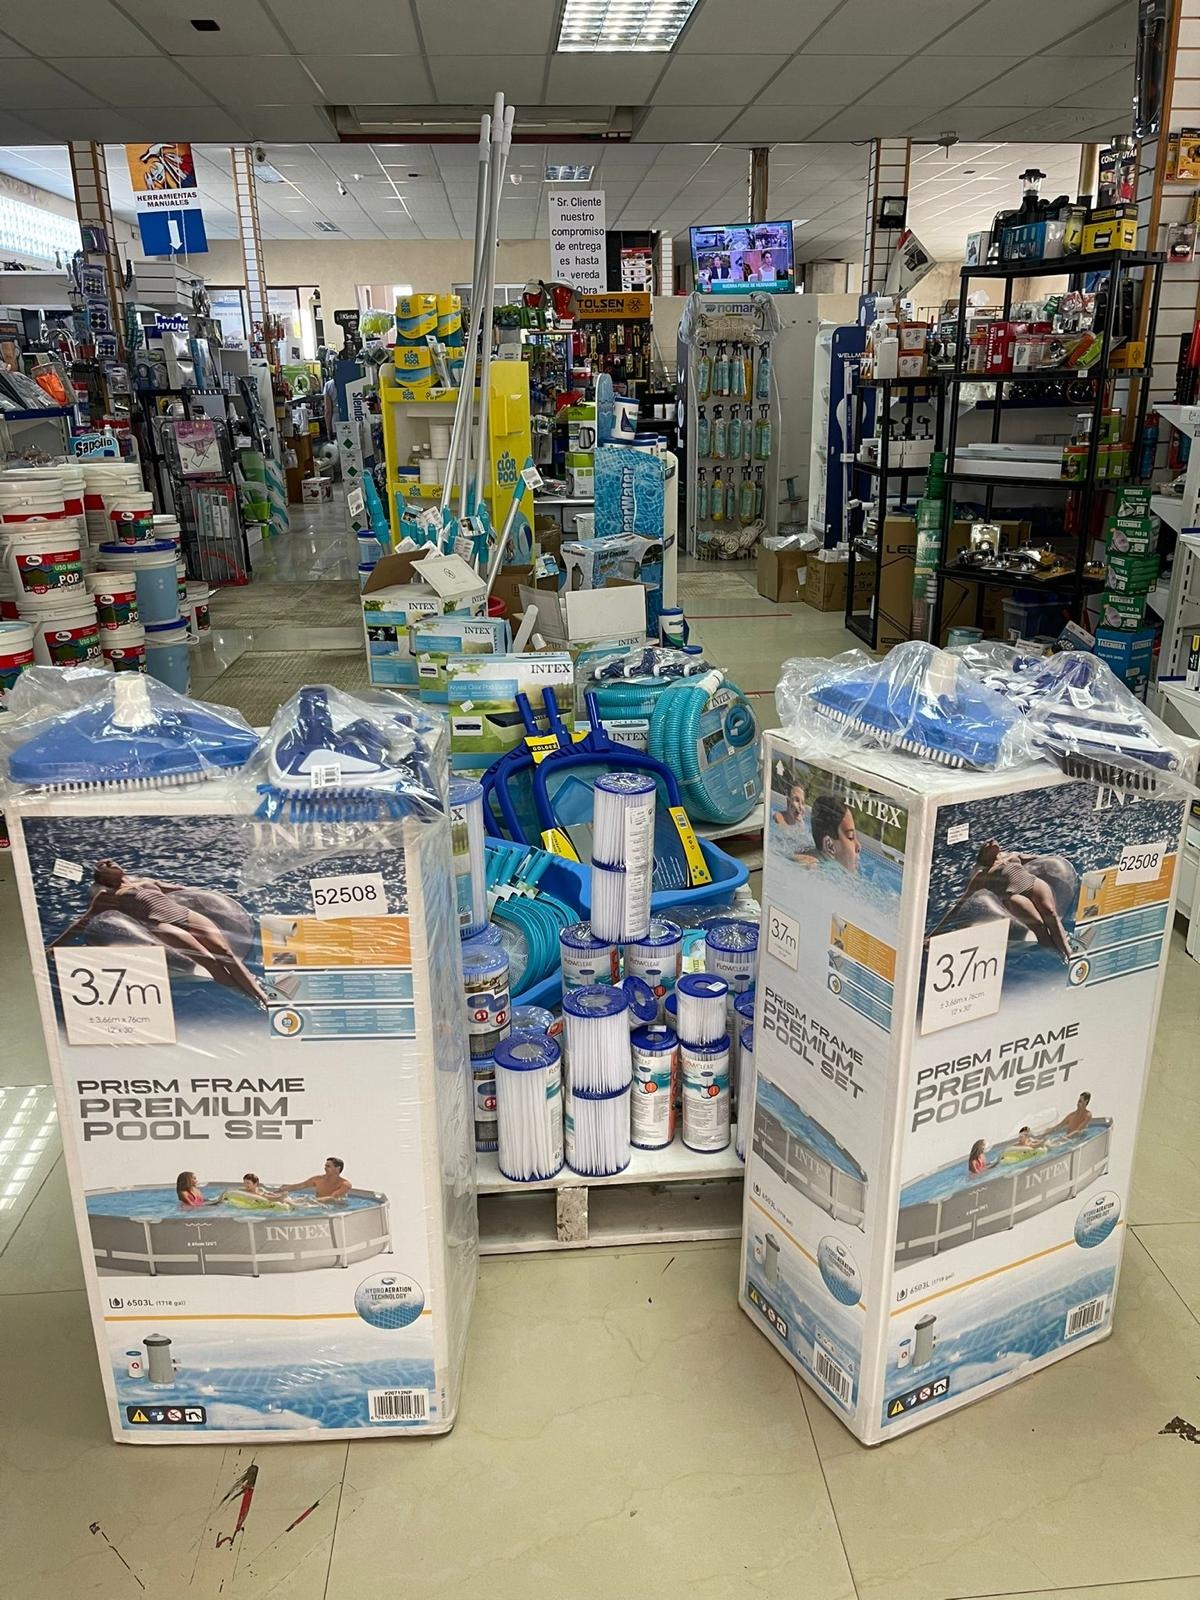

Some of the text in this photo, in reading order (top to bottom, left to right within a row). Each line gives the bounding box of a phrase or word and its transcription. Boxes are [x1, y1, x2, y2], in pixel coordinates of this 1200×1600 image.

[137, 191, 197, 201] HERRAMIENTAS
[147, 200, 189, 208] MANUALES
[570, 197, 602, 207] Cliente
[560, 212, 595, 222] nuestro
[551, 227, 605, 238] compromiso
[555, 242, 602, 253] de entrega
[575, 256, 599, 265] hasta
[570, 270, 600, 279] vereda
[577, 299, 625, 309] TOLSEN
[157, 322, 189, 330] HYUN
[986, 327, 996, 369] WARNING
[76, 437, 113, 457] Sapolio
[497, 459, 516, 471] CLOR
[498, 471, 518, 481] POOL
[621, 466, 635, 534] earWater
[59, 573, 81, 585] POP
[408, 602, 436, 611] INTEX
[464, 626, 491, 636] INTEX
[618, 638, 640, 646] INTEX
[531, 663, 571, 674] INTEX
[712, 692, 731, 707] INTEX
[612, 732, 648, 742] INTEX
[844, 787, 902, 828] INTEX
[1119, 853, 1159, 873] 52508
[315, 885, 377, 906] 52508
[771, 918, 797, 950] 3.7m
[933, 946, 998, 993] 3.7m
[70, 968, 162, 1006] 3.7m
[95, 1016, 121, 1024] 3.66m
[766, 987, 864, 1066] PRISM FRAME
[764, 999, 854, 1077] PREMIUM
[763, 1015, 864, 1099] POOL SET
[917, 1022, 1080, 1085] PRISM FRAME
[914, 1043, 1065, 1110] PREMIUM
[77, 1078, 305, 1095] PRISM FRAME
[912, 1061, 1078, 1133] POOL SET
[80, 1097, 288, 1118] PREMIUM
[83, 1119, 314, 1142] POOL SET
[1025, 1159, 1071, 1190] INTEX
[266, 1223, 330, 1241] INTEX
